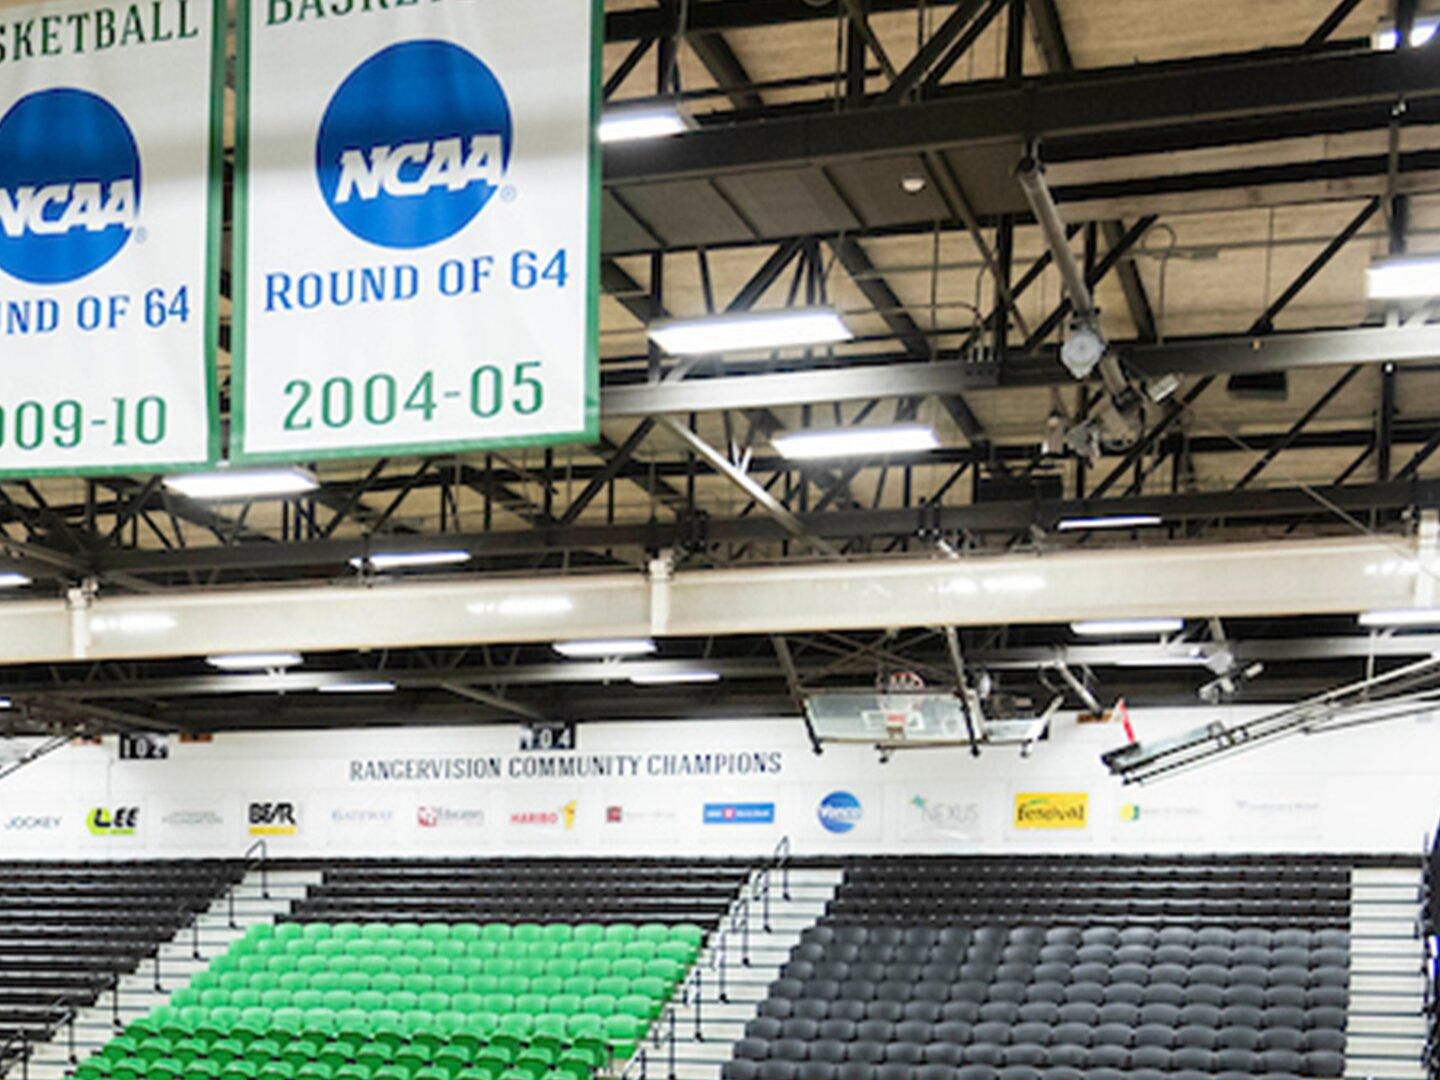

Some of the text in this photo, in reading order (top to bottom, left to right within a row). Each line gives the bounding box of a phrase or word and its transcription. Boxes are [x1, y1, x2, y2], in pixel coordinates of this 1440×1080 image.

[335, 134, 511, 203] NCAA
[264, 249, 569, 312] ROUND OF 64
[76, 295, 129, 329] OF
[143, 286, 189, 327] 64
[283, 361, 544, 432] 2004-05
[350, 751, 782, 782] RANGERVISION COMMUNITY CHAMPIONS
[94, 807, 139, 828] LEE
